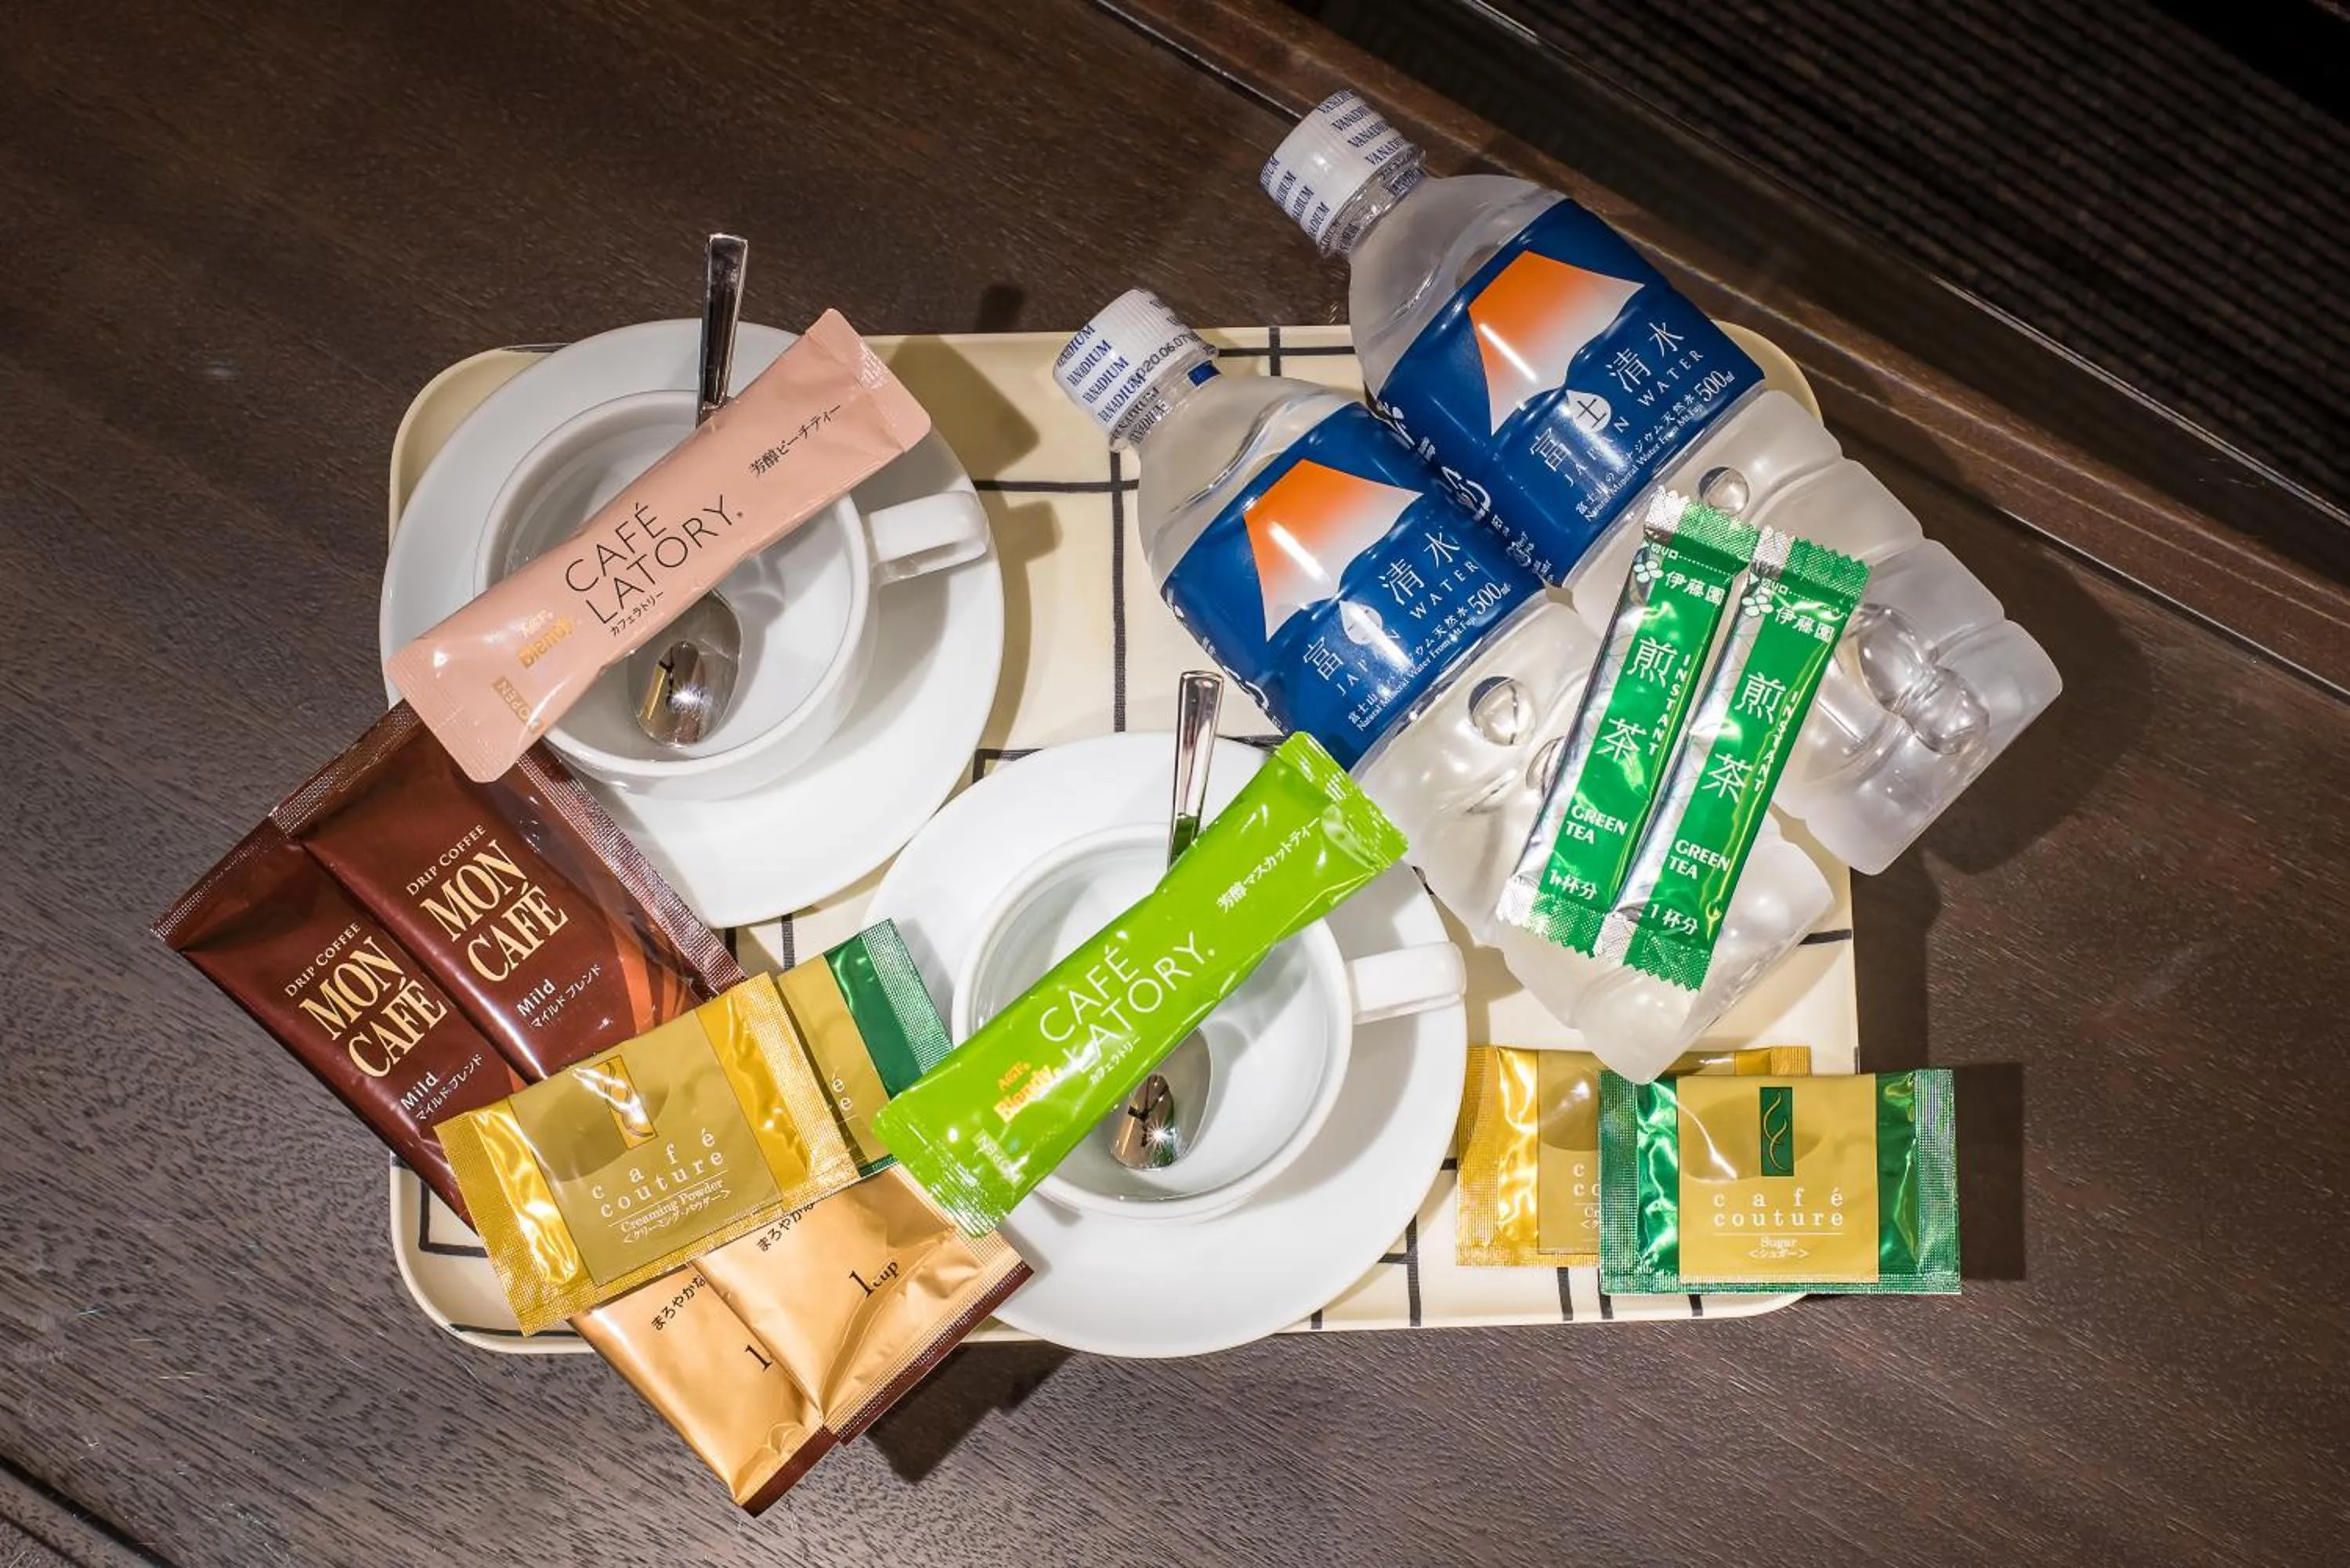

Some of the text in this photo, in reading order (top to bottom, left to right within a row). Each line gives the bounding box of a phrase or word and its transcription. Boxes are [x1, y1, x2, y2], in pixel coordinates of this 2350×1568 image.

[1636, 349, 1705, 407] WATER
[565, 503, 672, 594] CAFÉ
[610, 591, 664, 638] カフェラトリー
[1409, 560, 1479, 619] WATER
[1665, 570, 1726, 607] 伊藤園
[1774, 605, 1835, 644] 伊藤園
[498, 681, 530, 720] OPEN
[1596, 636, 1678, 764] 煎茶
[1647, 654, 1690, 756] INSTANT
[1701, 671, 1787, 803] 煎茶
[1753, 692, 1799, 791] INSTANT
[1566, 822, 1596, 845] TEA
[1571, 802, 1629, 836] GREEN
[405, 824, 487, 898] DRIP COFFEE
[1668, 856, 1699, 880] TEA
[1675, 839, 1731, 870] GREEN
[420, 840, 528, 941] MON
[1649, 903, 1699, 935] 1杯分
[284, 921, 361, 997] DRIP COFFEE
[468, 883, 569, 983] CAFÉ
[299, 936, 404, 1042] MON
[515, 978, 556, 1018] Mild
[1040, 946, 1138, 1043] CAFÉ
[349, 976, 447, 1078] CAFÉ
[400, 1071, 439, 1113] Mild
[592, 1128, 714, 1199] café
[601, 1152, 723, 1217] couture
[620, 1179, 723, 1232] Creaming Powder
[1713, 1186, 1844, 1209] café
[1713, 1209, 1844, 1227] couture
[1759, 1236, 1797, 1250] Sugar
